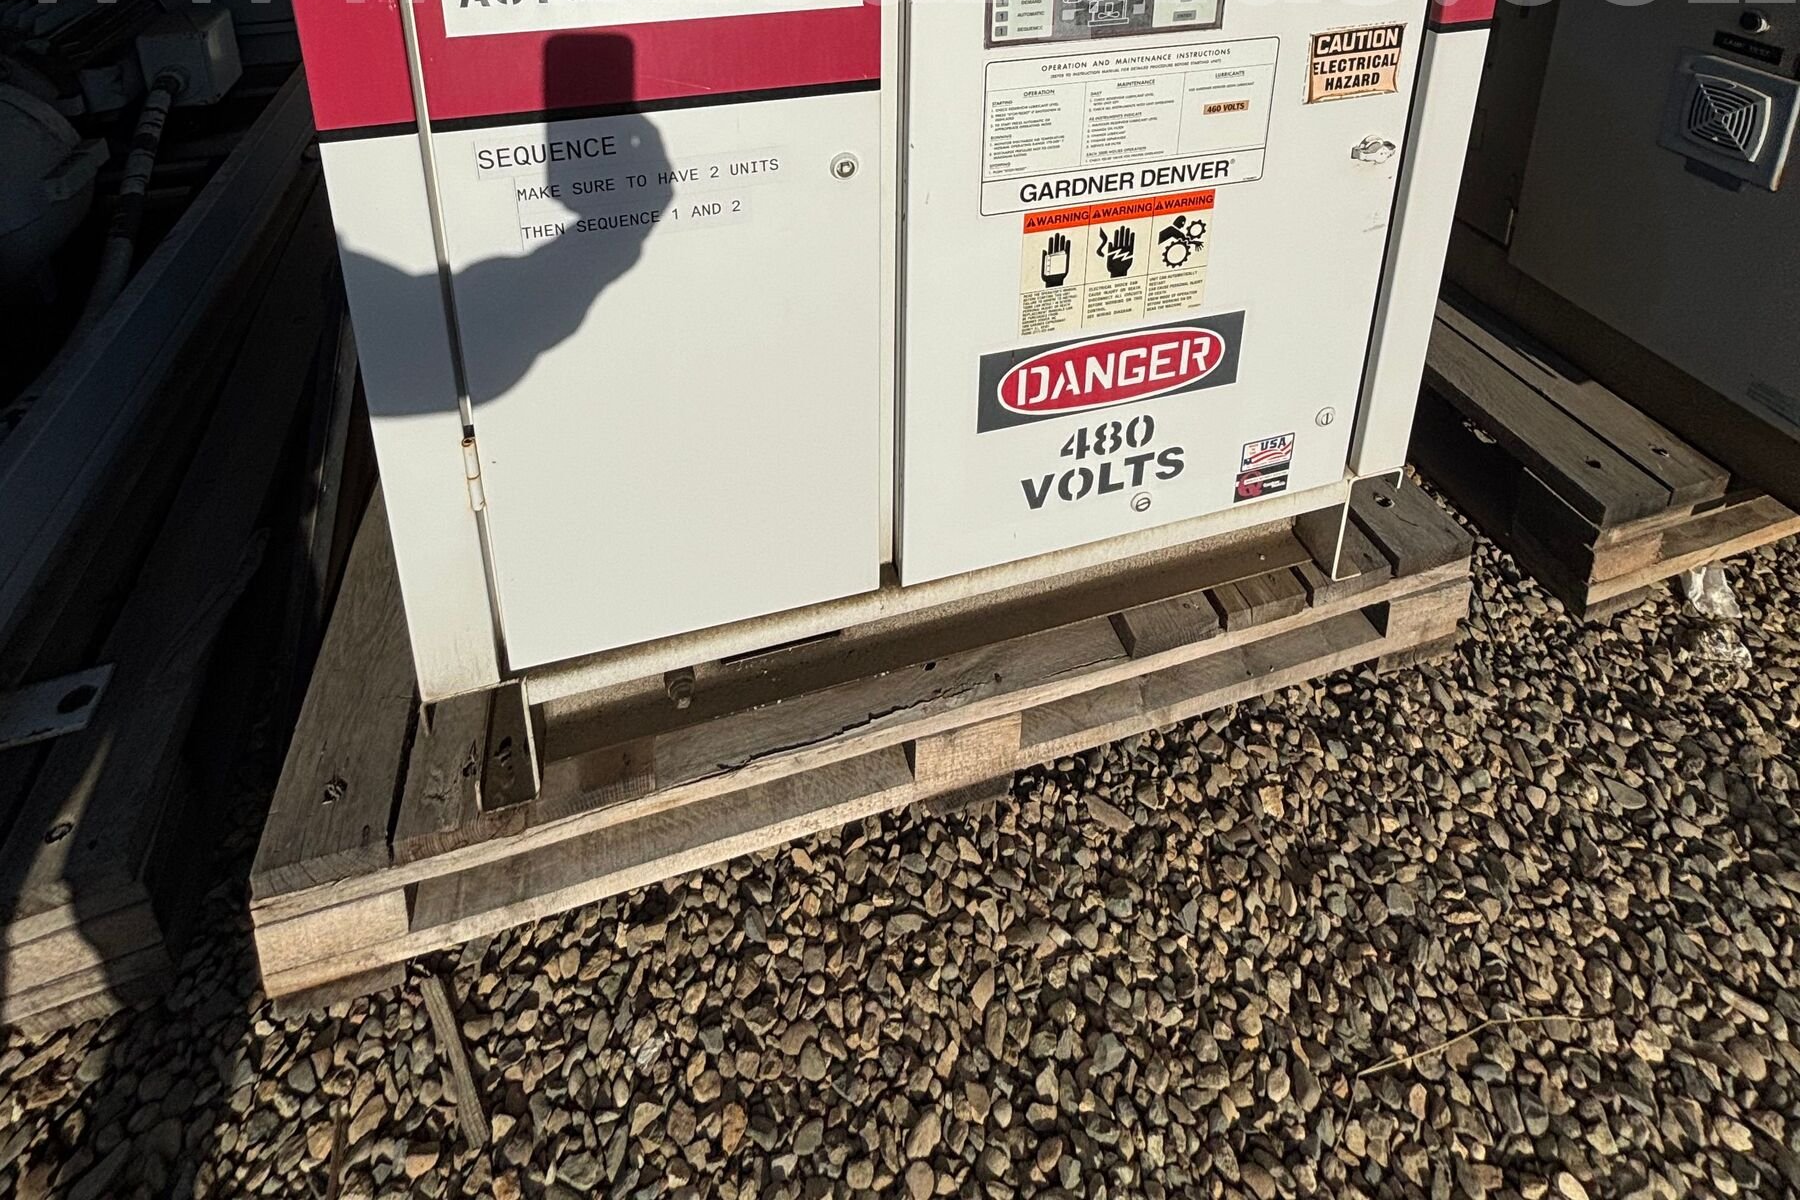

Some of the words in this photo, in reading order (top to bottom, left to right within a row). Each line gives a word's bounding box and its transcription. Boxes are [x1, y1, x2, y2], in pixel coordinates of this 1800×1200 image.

[1316, 27, 1399, 55] CAUTION
[1041, 61, 1087, 71] OPERATION
[1092, 59, 1109, 67] AND
[1115, 53, 1171, 64] MAINTENANCE
[1176, 47, 1230, 59] INSTRUCTIONS
[1313, 53, 1397, 75] ELECTRICAL
[1023, 89, 1055, 97] OPERATION
[1117, 78, 1155, 87] MAINTENANCE
[1324, 72, 1380, 91] HAZARD
[1207, 104, 1221, 113] 460
[1223, 102, 1245, 112] VOLTS
[478, 136, 617, 170] SEQUENCE
[517, 185, 561, 202] MAKE
[572, 178, 616, 196] SURE
[626, 174, 647, 189] TO
[658, 168, 699, 186] HAVE
[709, 166, 720, 179] 2
[730, 158, 779, 176] UNITS
[1019, 171, 1134, 203] GARDNER
[1100, 202, 1152, 218] WARNING
[1163, 194, 1214, 210] WARNING
[522, 223, 566, 240] THEN
[576, 210, 660, 233] SEQUENCE
[671, 208, 679, 220] 1
[691, 203, 722, 218] AND
[732, 200, 741, 213] 2
[1035, 210, 1089, 225] WARNING
[1017, 337, 1211, 406] DANGER
[1060, 414, 1155, 460] 480
[1261, 437, 1286, 451] USA
[1021, 447, 1185, 509] VOLTS
